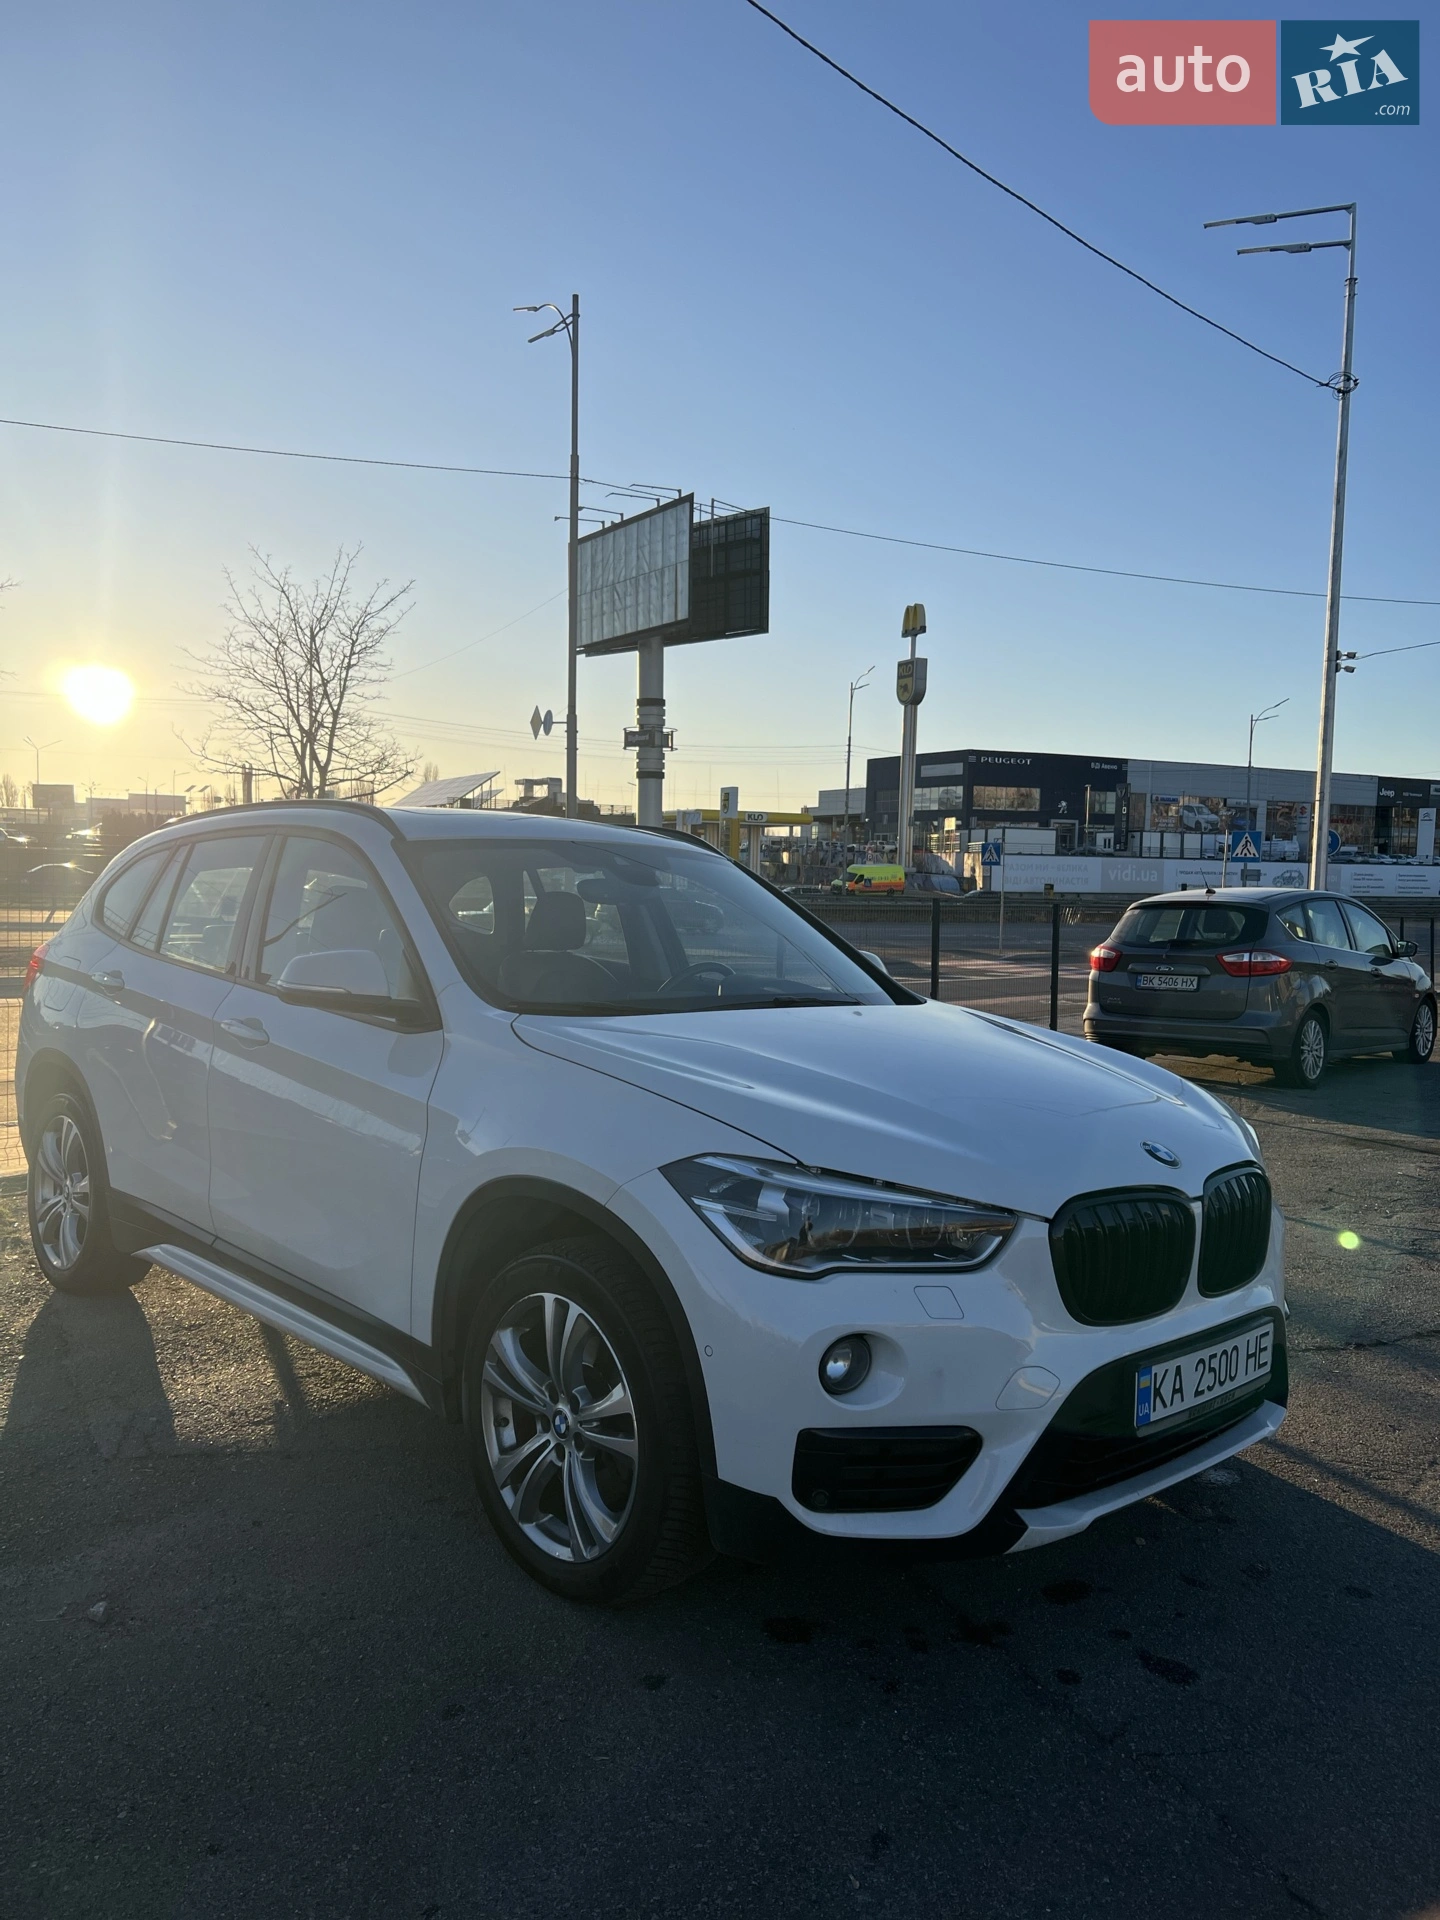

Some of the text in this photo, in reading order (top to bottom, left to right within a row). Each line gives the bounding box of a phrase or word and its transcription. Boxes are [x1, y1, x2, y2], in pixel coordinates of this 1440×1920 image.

[980, 756, 1032, 766] PEUGEOT
[1379, 787, 1395, 798] Jeep
[747, 813, 764, 821] KLO
[1108, 863, 1158, 882] vidi.ua
[1141, 975, 1196, 988] BK 5406 HX
[1138, 1330, 1270, 1417] UA KA 2500 HE
